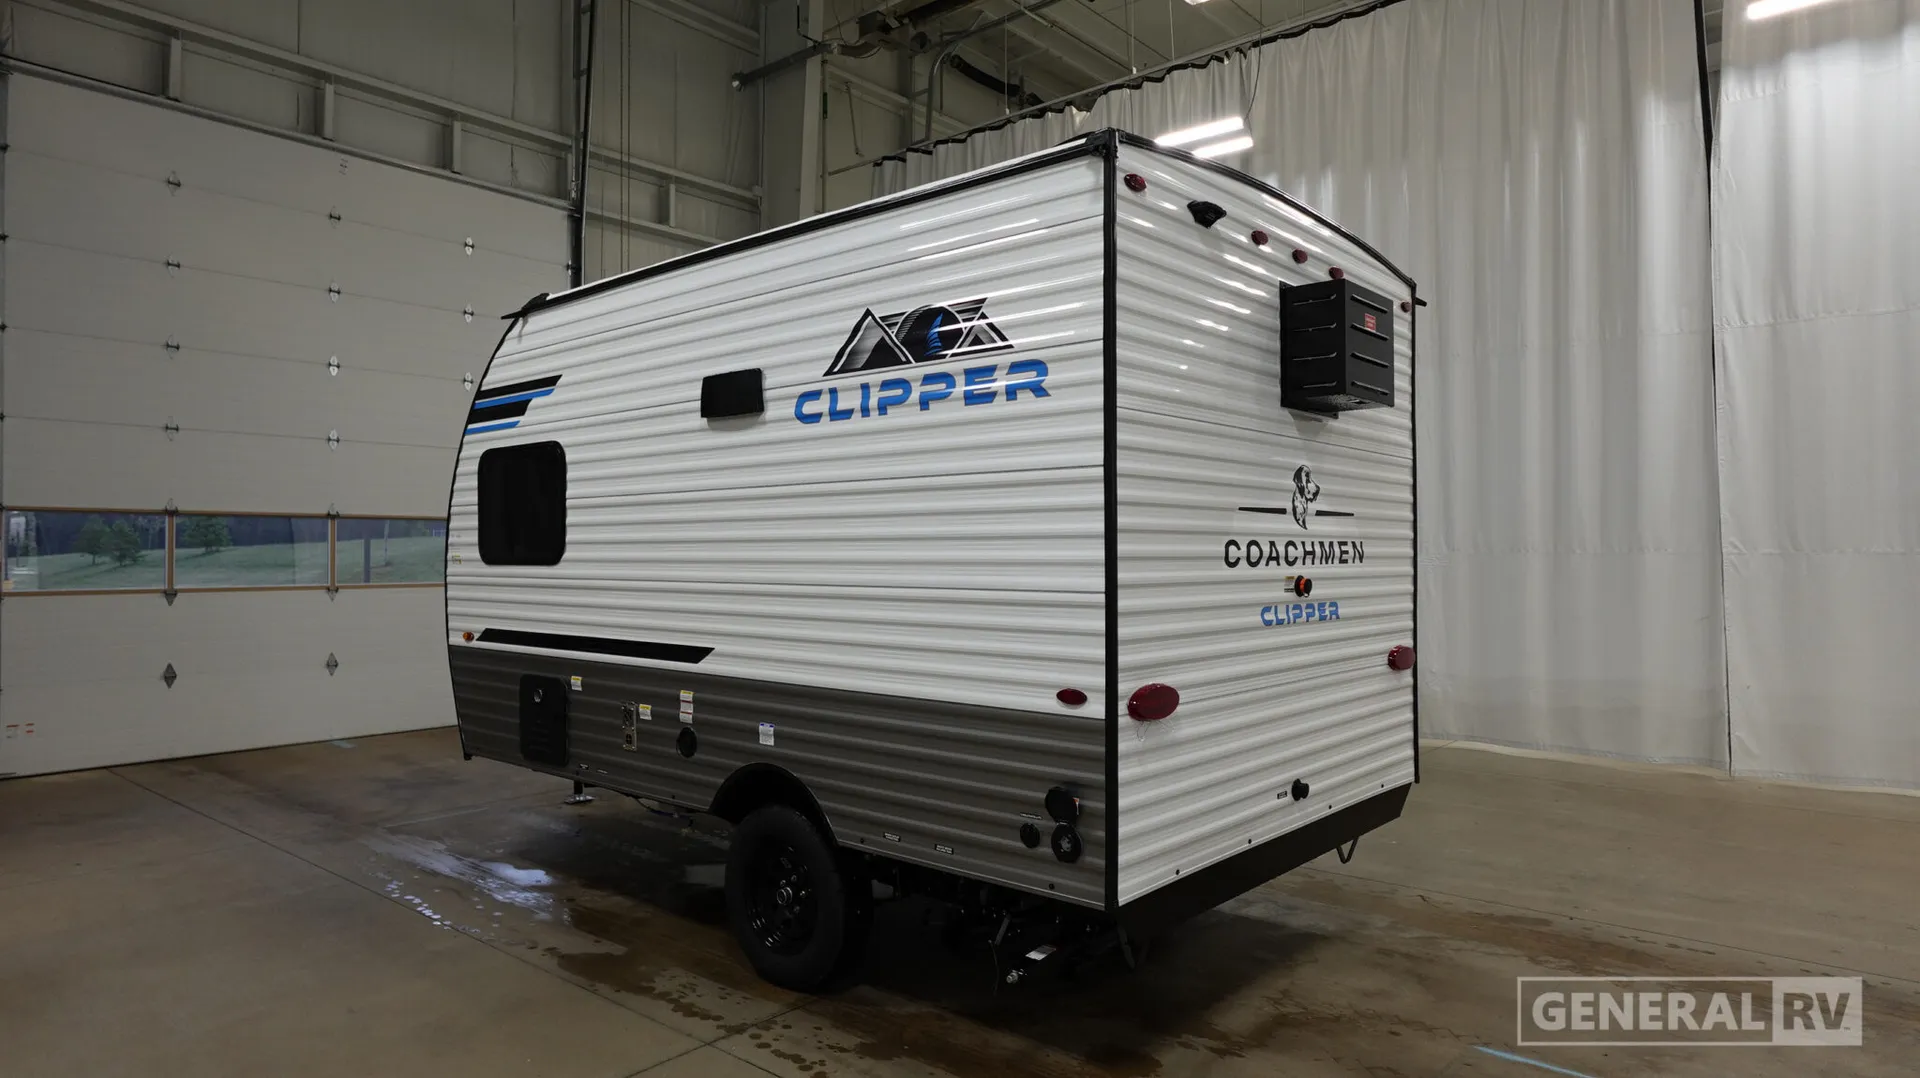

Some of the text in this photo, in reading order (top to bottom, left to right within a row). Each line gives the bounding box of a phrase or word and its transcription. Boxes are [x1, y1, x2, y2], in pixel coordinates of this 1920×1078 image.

[794, 359, 1051, 424] CLIPPER
[1224, 539, 1364, 568] COACHMEN
[1261, 601, 1340, 626] CLIPPER
